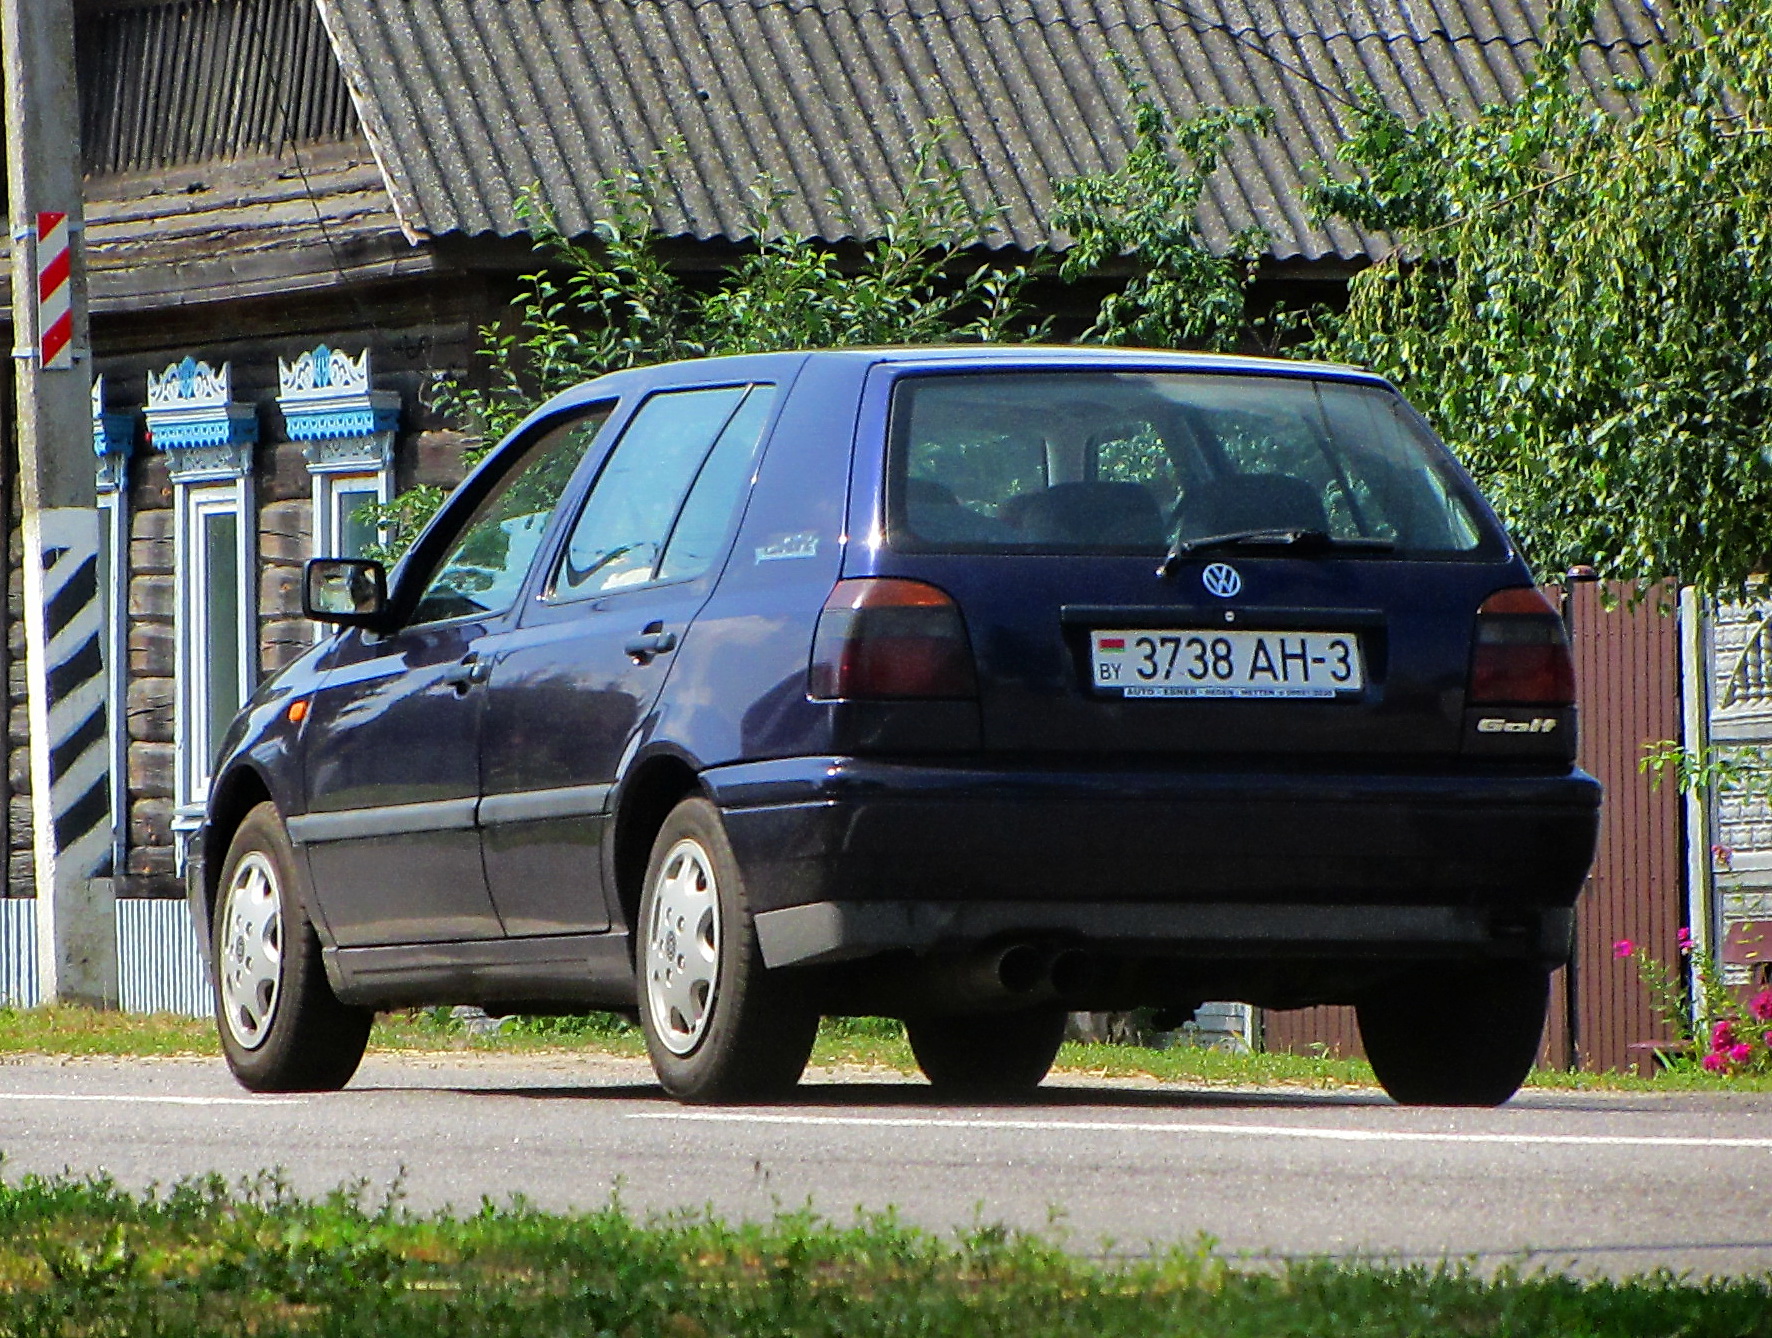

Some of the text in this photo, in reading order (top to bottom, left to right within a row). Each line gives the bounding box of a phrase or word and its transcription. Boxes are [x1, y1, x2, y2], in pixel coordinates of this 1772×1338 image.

[1203, 563, 1241, 597] VW
[1099, 662, 1121, 680] BY
[1135, 636, 1351, 681] 3738 AH-3
[1477, 718, 1557, 733] Golf
